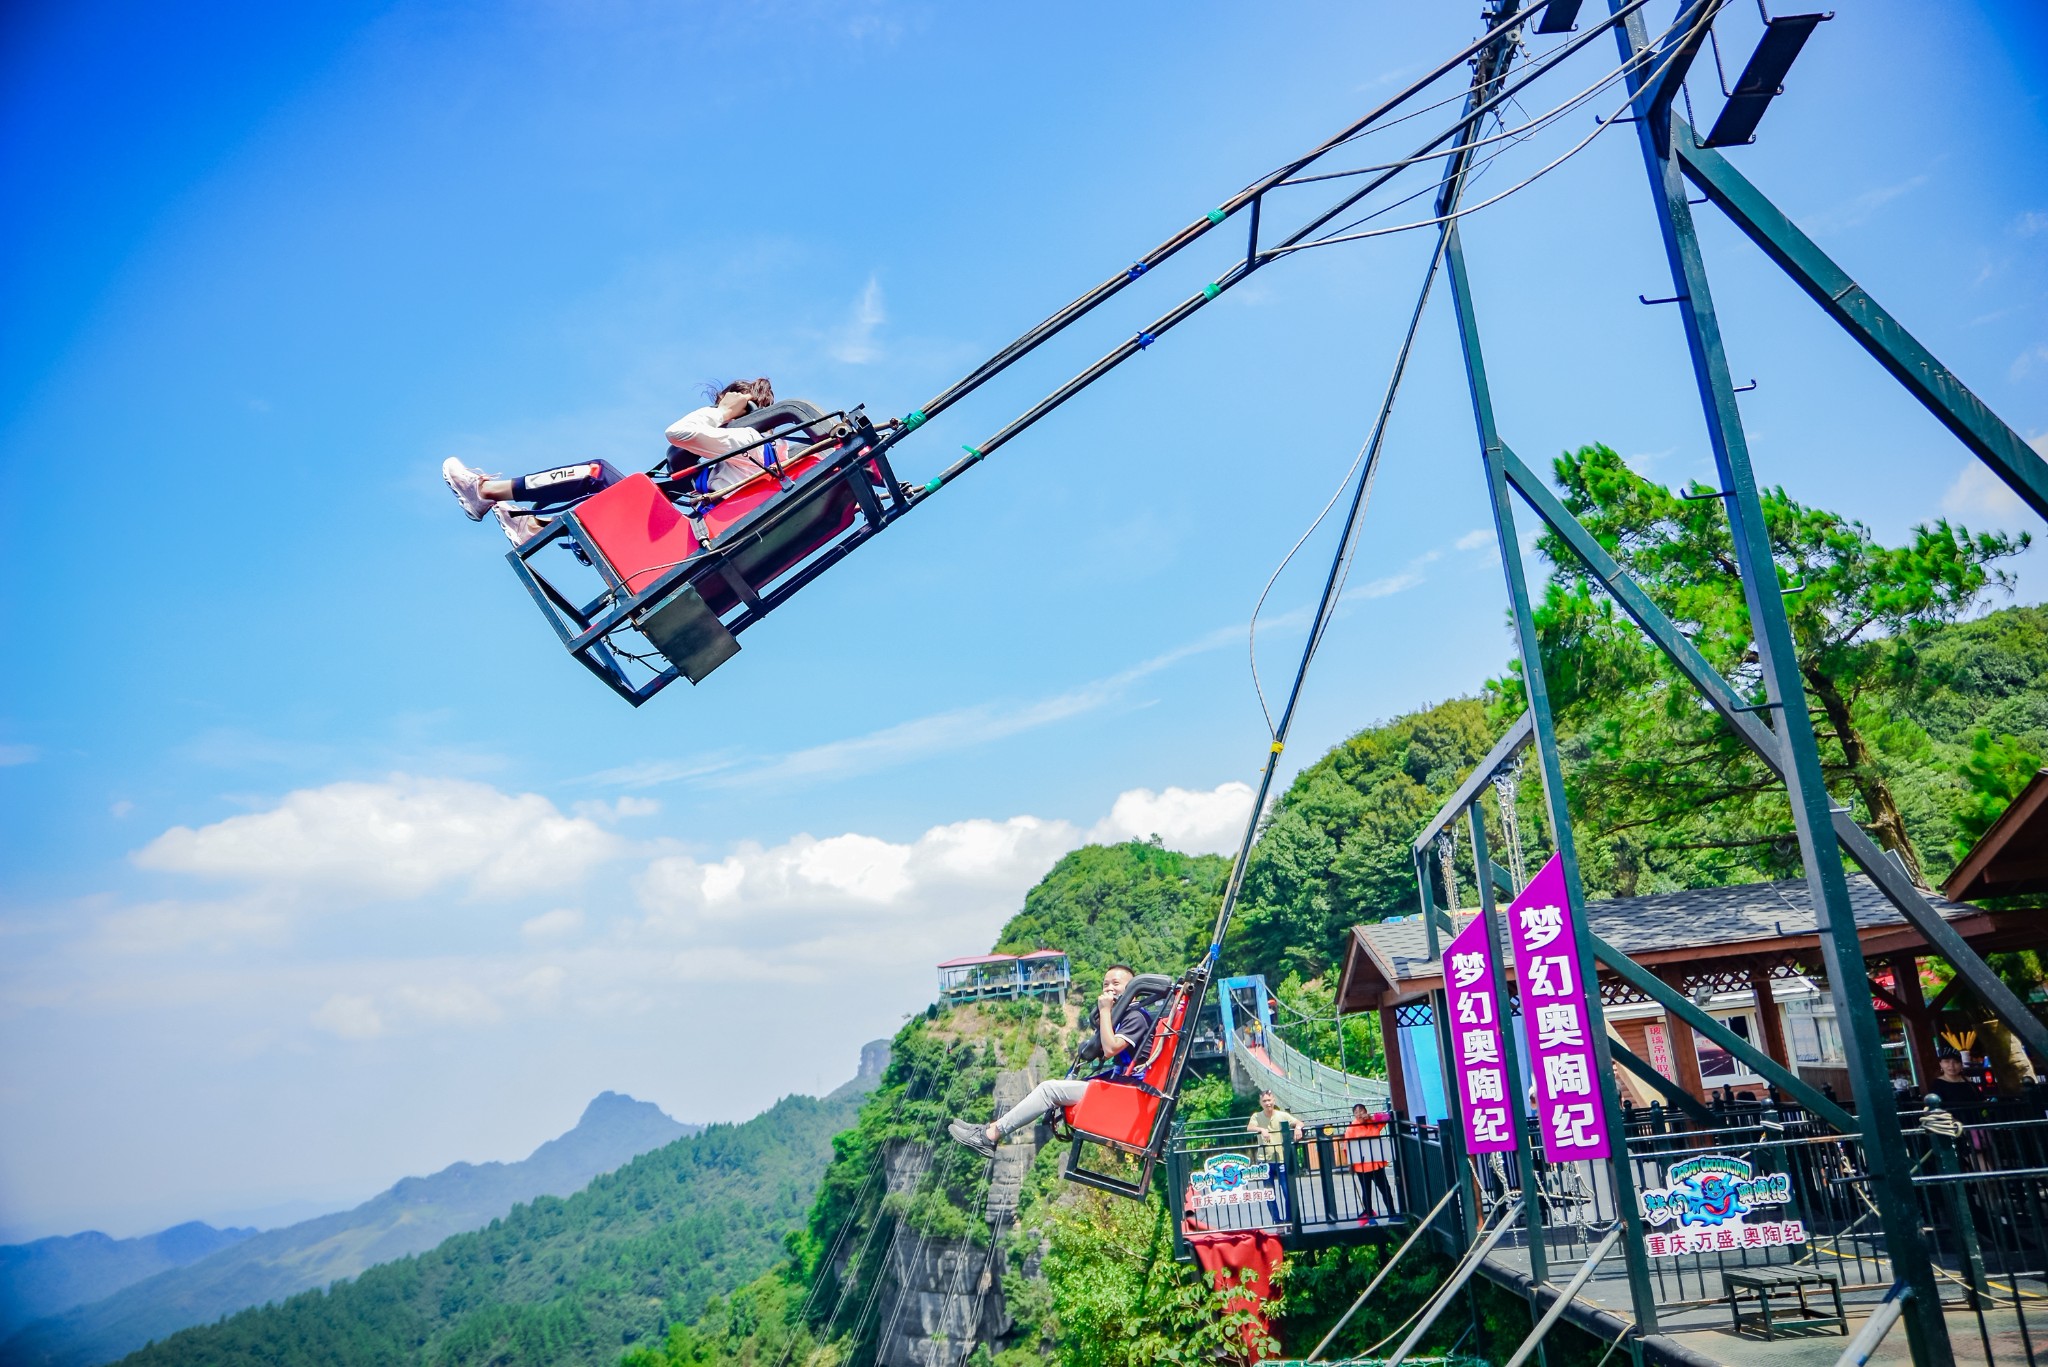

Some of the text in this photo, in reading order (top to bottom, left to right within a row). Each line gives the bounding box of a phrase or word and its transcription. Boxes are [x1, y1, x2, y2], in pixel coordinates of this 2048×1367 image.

[549, 469, 575, 480] FILA
[1451, 951, 1510, 1143] 梦幻奥陶纪
[1519, 904, 1600, 1148] 梦幻奥陶纪
[1643, 1176, 1788, 1223] 梦幻 奥陶纪
